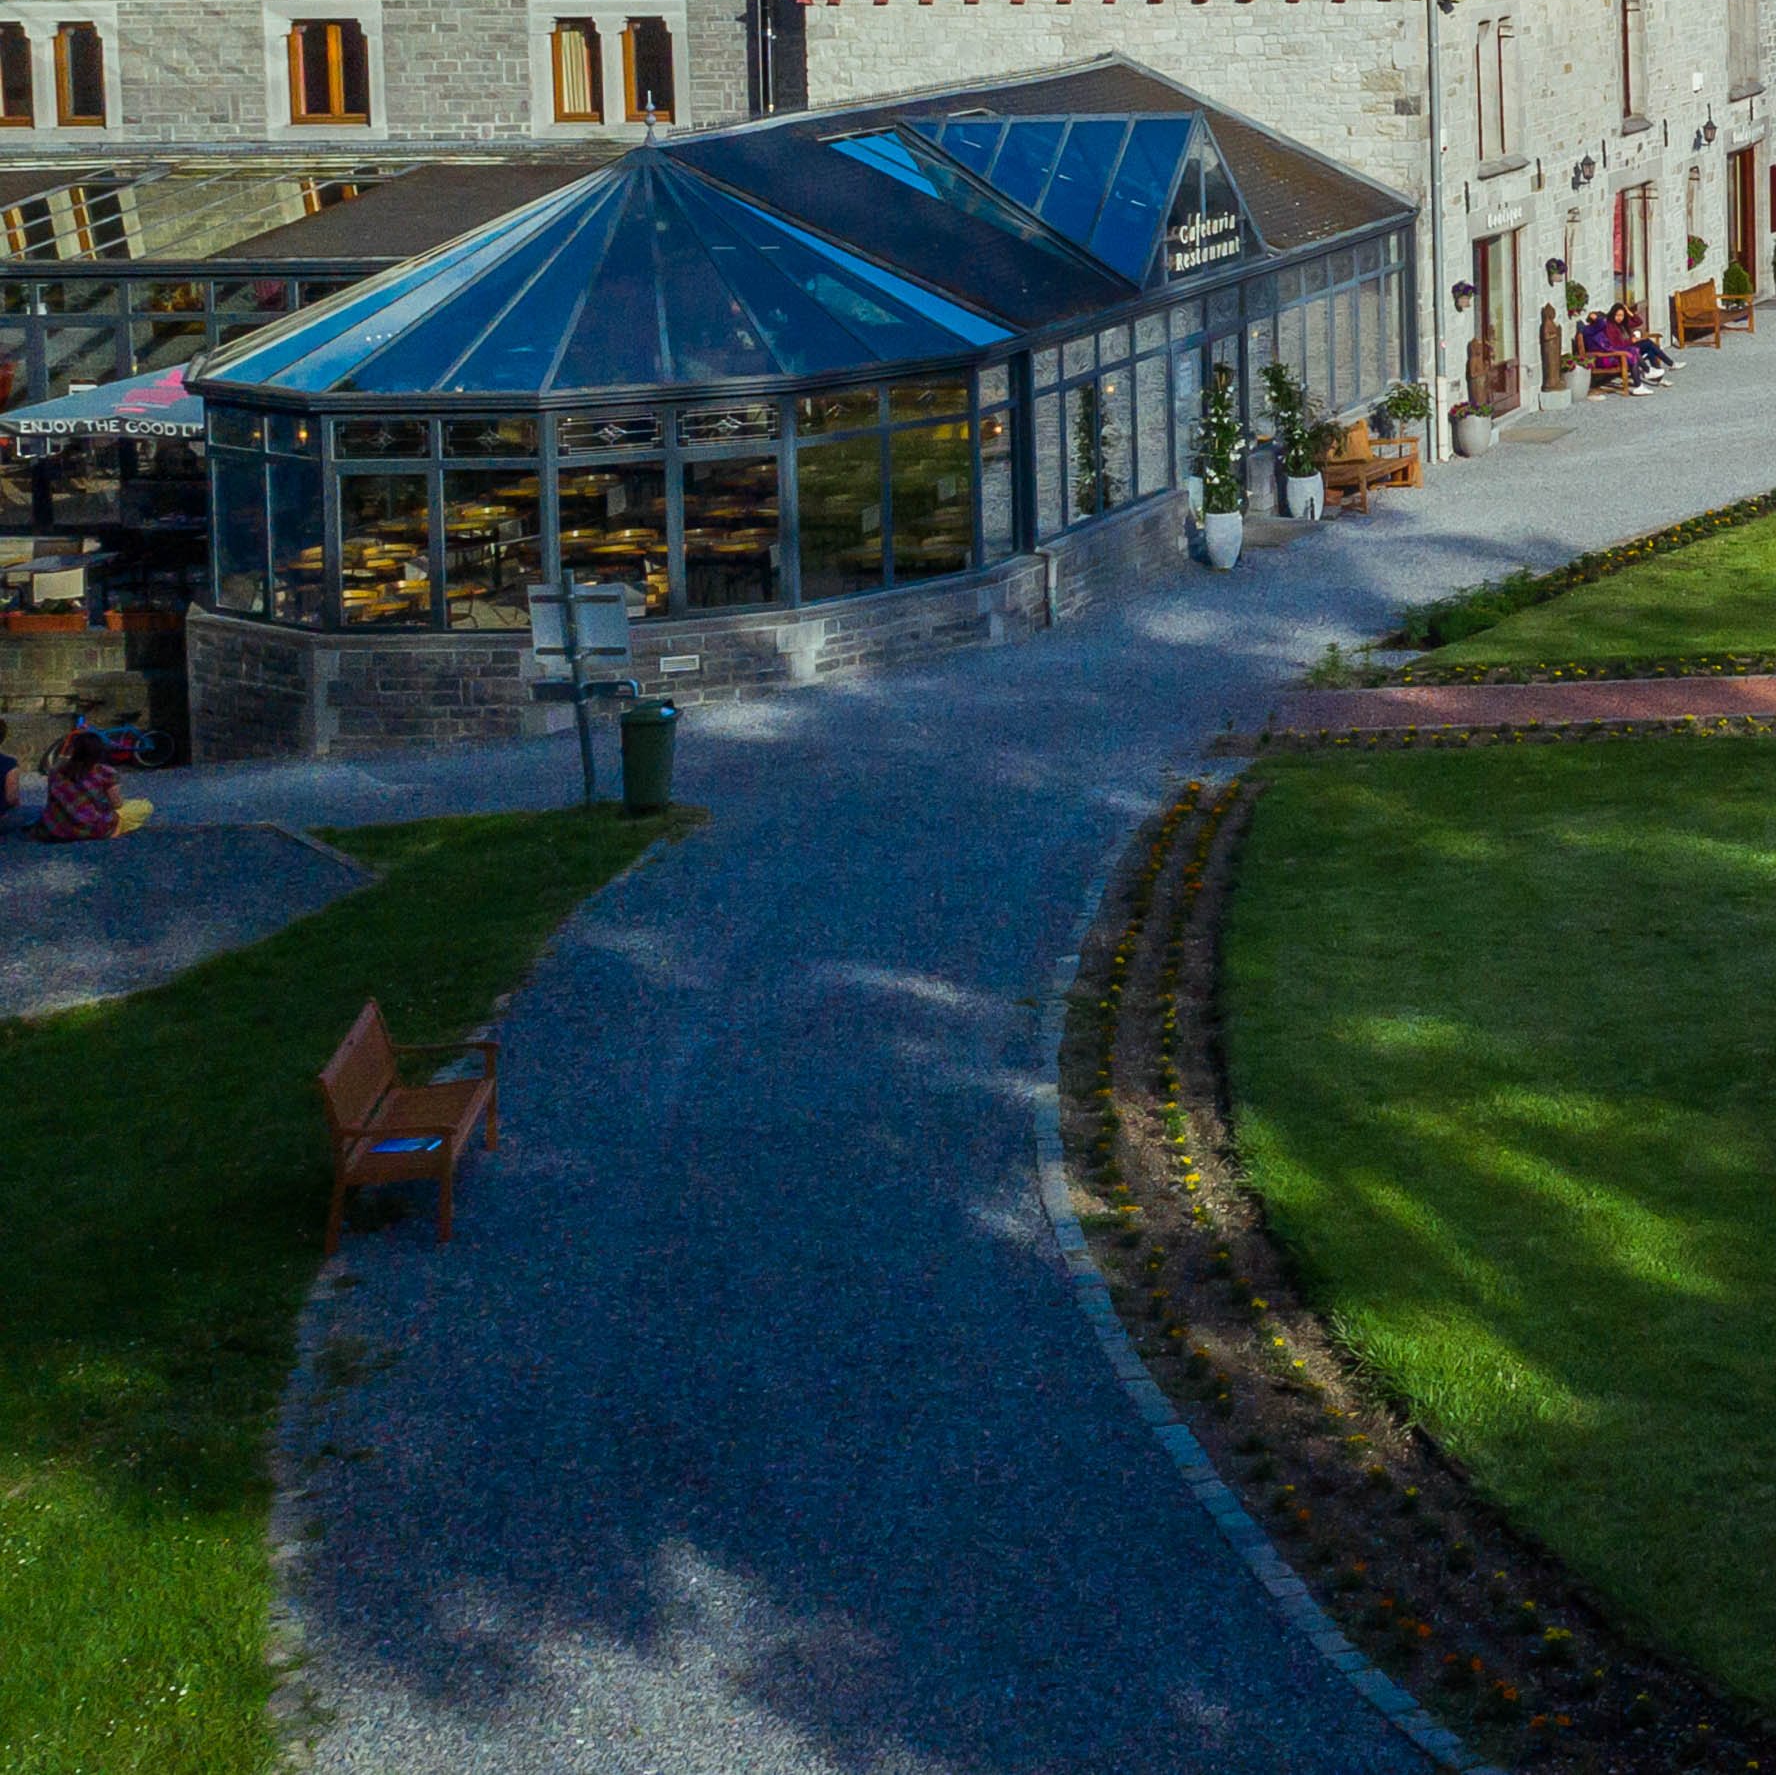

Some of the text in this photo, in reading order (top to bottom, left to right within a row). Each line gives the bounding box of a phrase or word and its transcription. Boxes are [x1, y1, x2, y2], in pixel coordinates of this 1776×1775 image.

[1175, 235, 1241, 272] Restaurant
[19, 419, 77, 434] ENJOY
[83, 419, 120, 433] THE
[125, 422, 177, 436] GOOD
